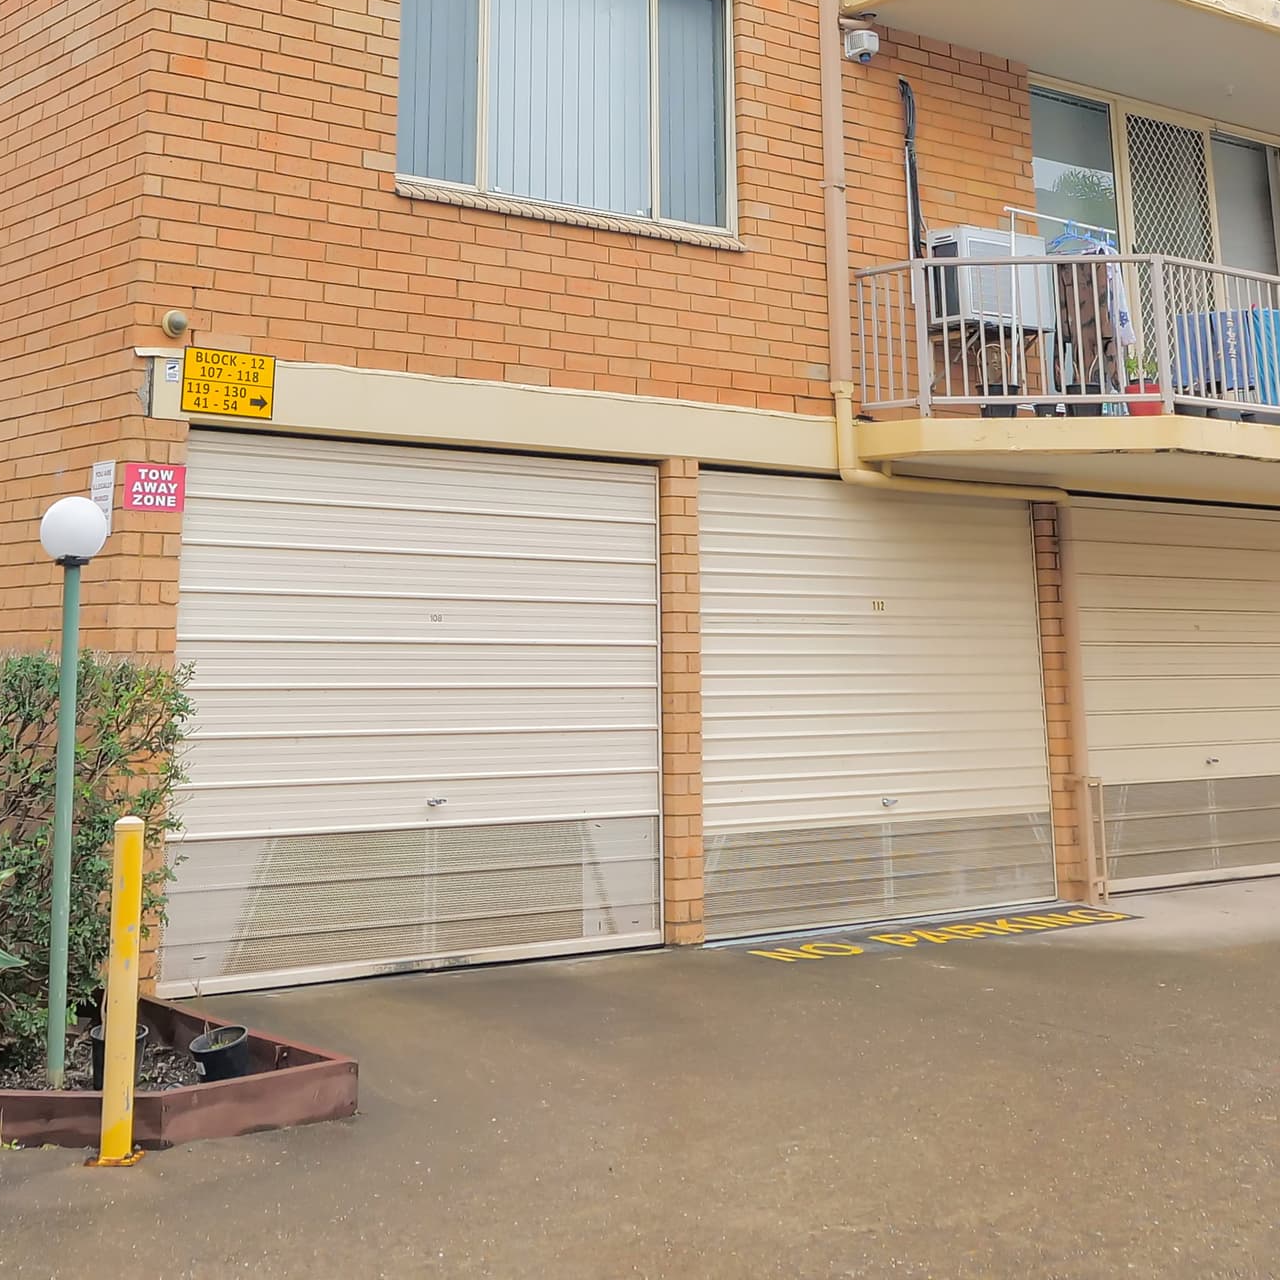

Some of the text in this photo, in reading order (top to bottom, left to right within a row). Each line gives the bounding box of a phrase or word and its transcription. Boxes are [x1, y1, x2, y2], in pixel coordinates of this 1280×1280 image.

[195, 351, 237, 367] BLOCK
[250, 358, 265, 370] 12
[200, 366, 223, 379] 107
[237, 370, 259, 383] 118
[187, 381, 210, 394] 119
[224, 386, 247, 398] 130
[193, 396, 209, 409] 41
[222, 399, 238, 411] 54
[137, 468, 174, 481] TOW
[131, 481, 178, 494] AWAY
[132, 494, 177, 507] ZONE
[872, 600, 885, 611] 112
[747, 908, 1132, 963] NO PARKING
